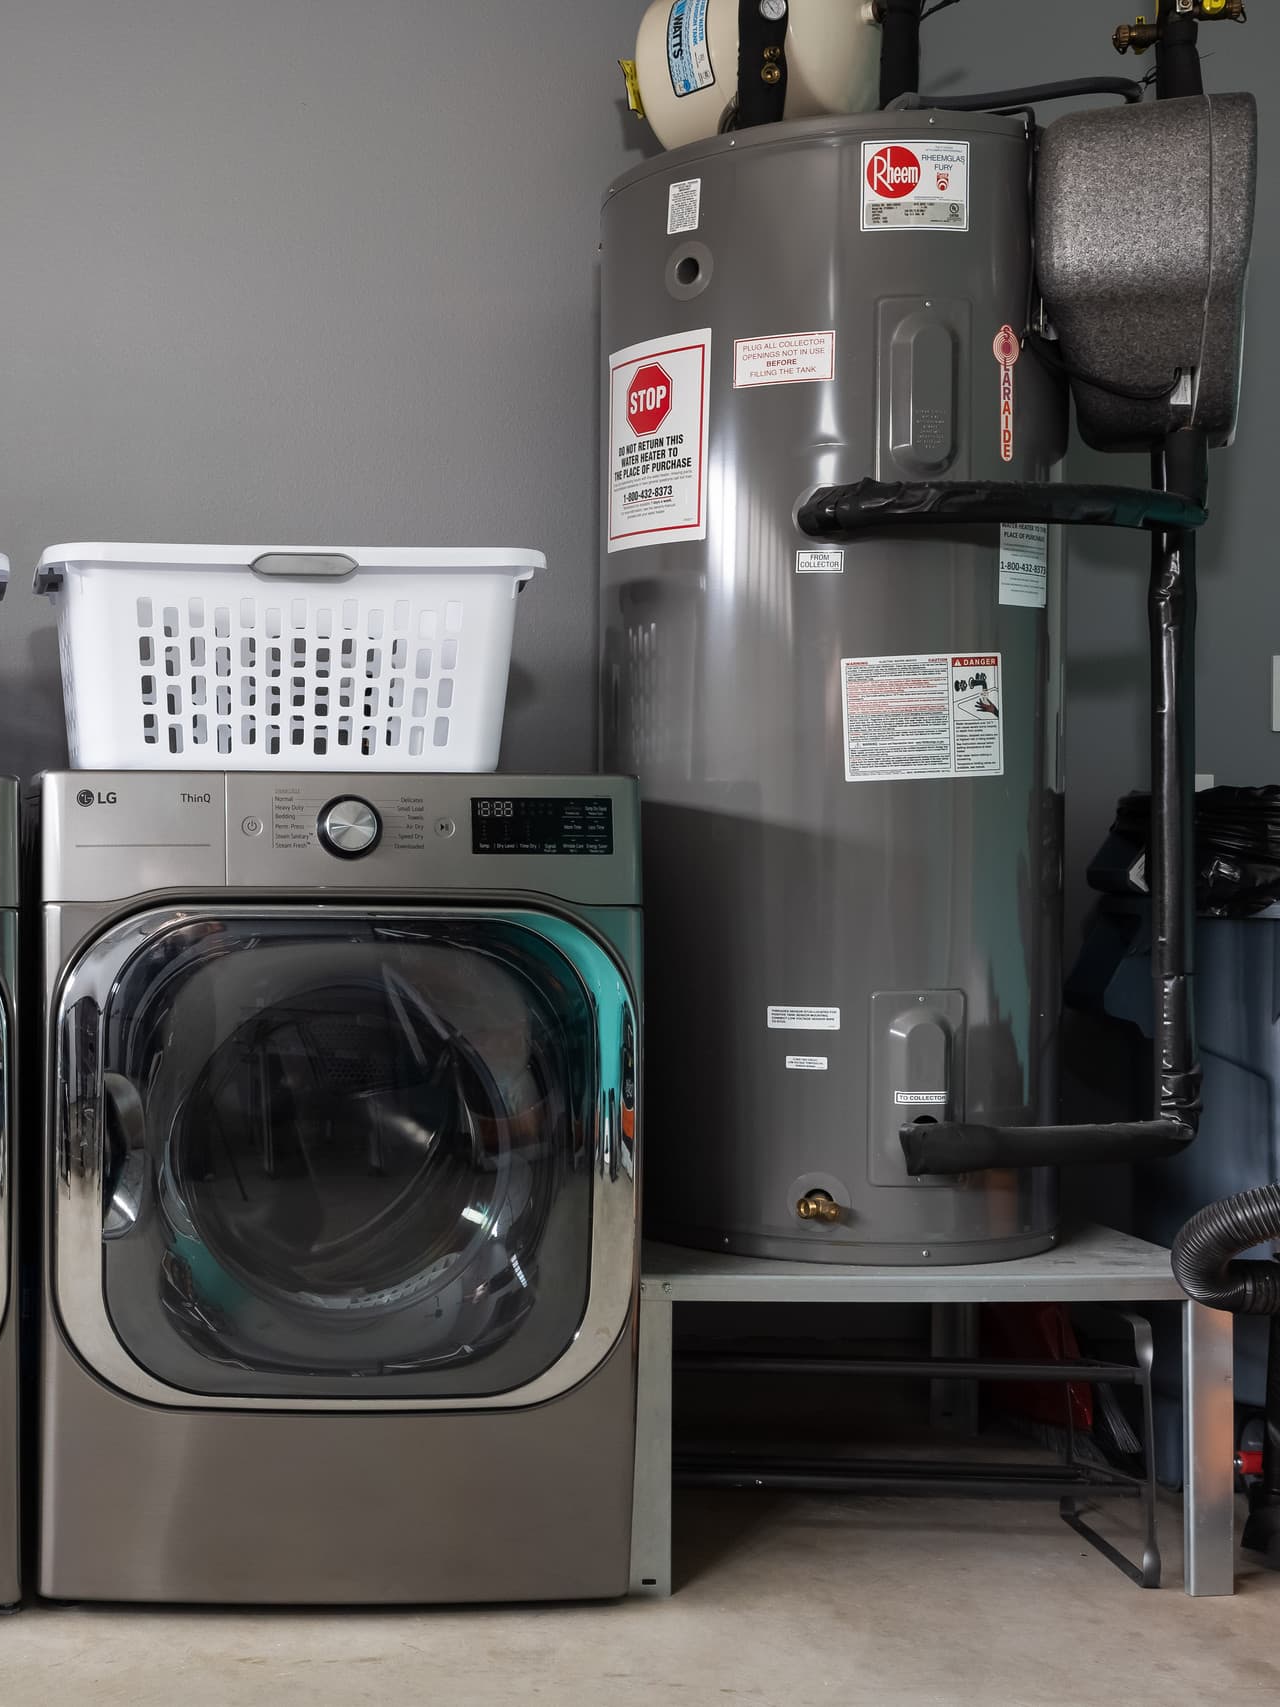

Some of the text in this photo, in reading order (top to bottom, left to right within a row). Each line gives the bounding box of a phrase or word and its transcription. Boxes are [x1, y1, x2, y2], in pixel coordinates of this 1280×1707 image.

[672, 13, 685, 59] WATTS
[921, 154, 966, 163] RHEEMGLAS
[873, 148, 919, 192] Rheem
[742, 338, 825, 352] PLUG ALL COLLECTOR
[742, 351, 781, 361] OPENINGS
[782, 349, 797, 357] NOT
[809, 347, 825, 355] USE
[766, 358, 797, 367] BEFORE
[749, 365, 817, 378] FILLING THE TANK
[629, 385, 667, 415] STOP
[618, 434, 684, 457] DO NOT RETURN THIS
[621, 447, 678, 468] WATER HEATER TO
[614, 471, 622, 482] THE
[623, 465, 640, 479] PLACE
[641, 464, 650, 475] OF
[652, 457, 692, 473] PURCHASE
[623, 485, 673, 504] 1-800-432-8373
[963, 657, 996, 666] DANGER
[97, 791, 211, 804] LG ThinQ
